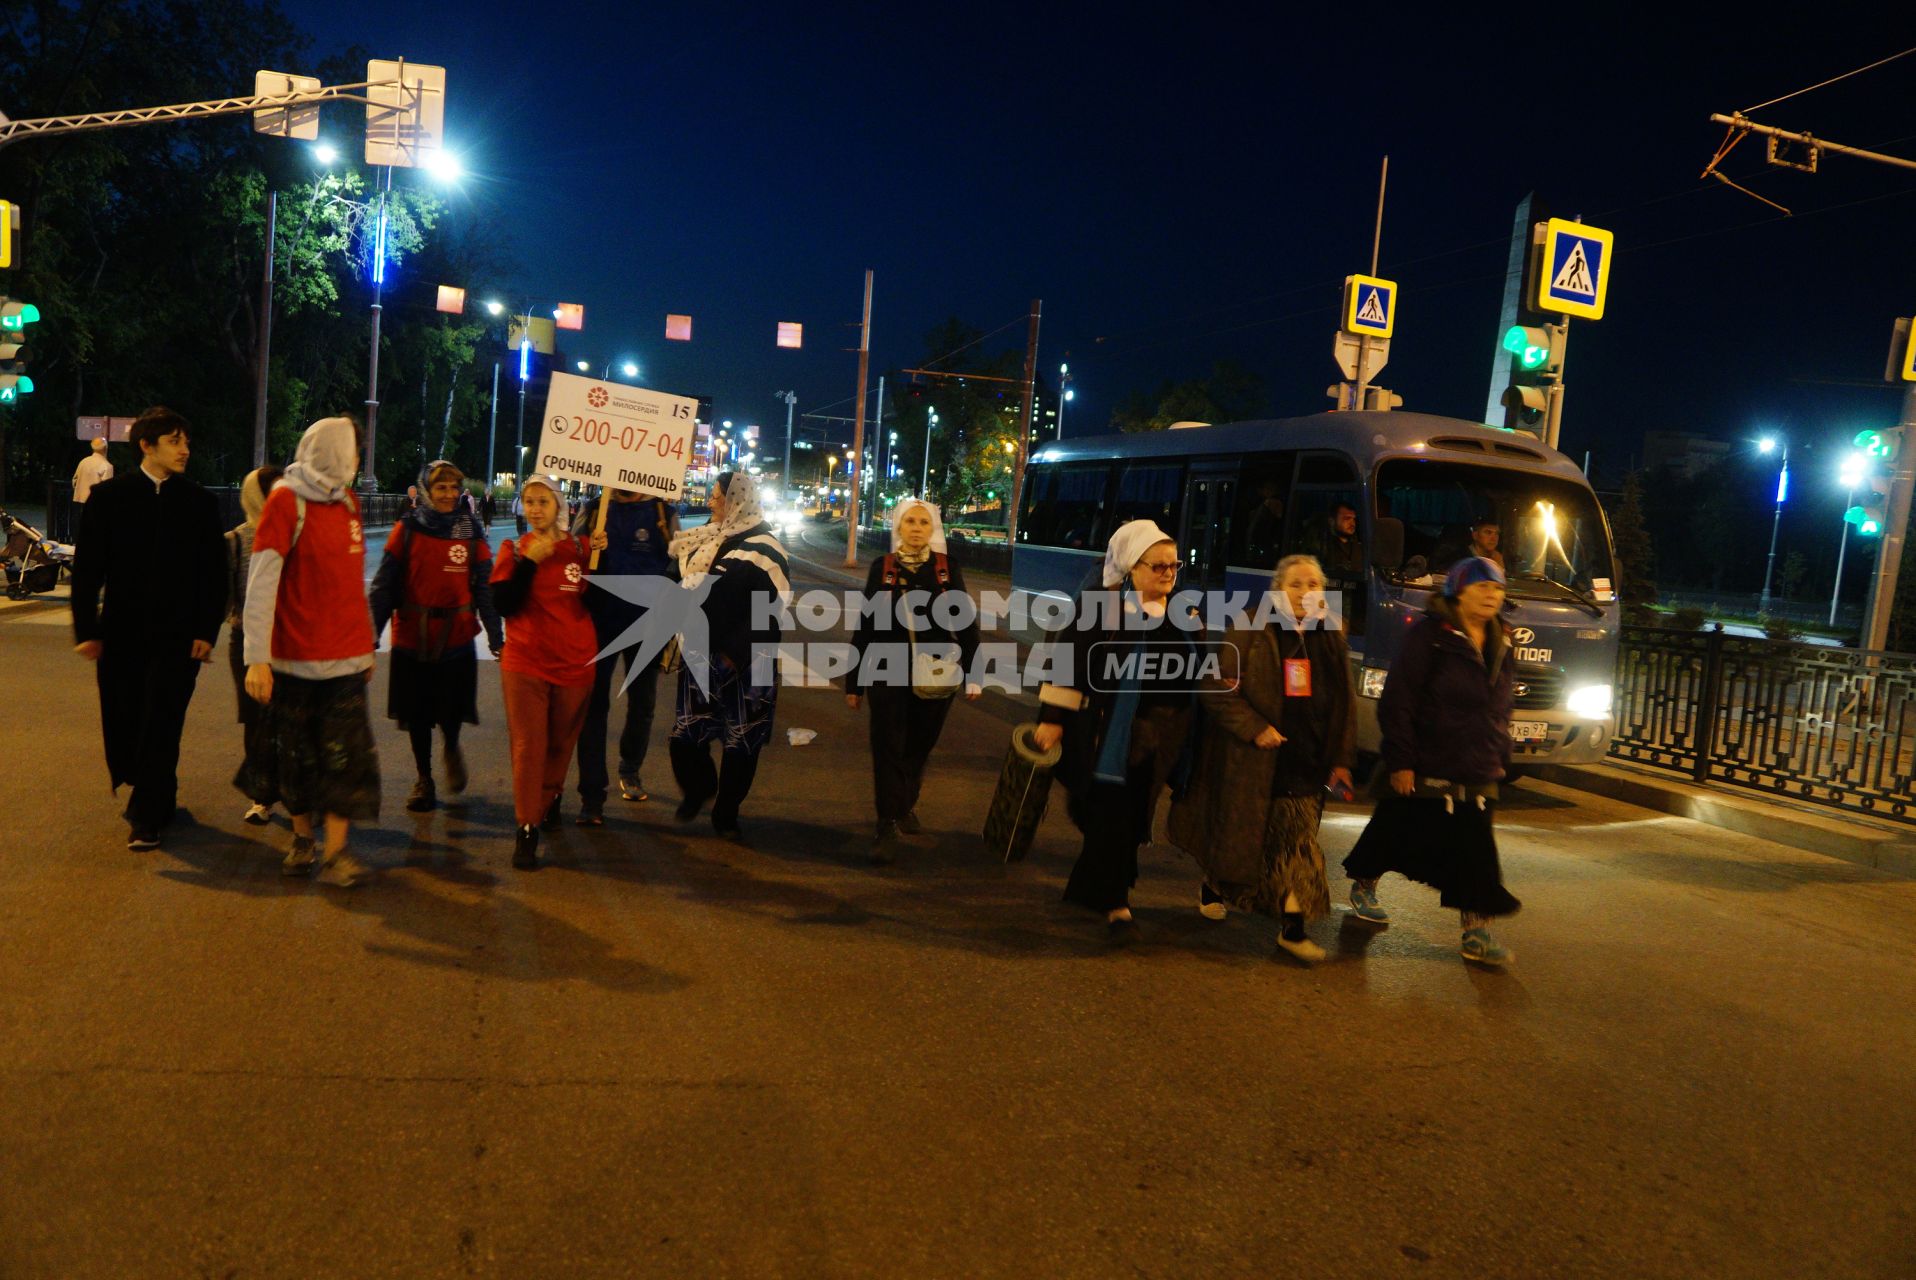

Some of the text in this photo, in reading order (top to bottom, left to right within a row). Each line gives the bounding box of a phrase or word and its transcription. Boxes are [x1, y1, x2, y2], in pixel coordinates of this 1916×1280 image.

[612, 401, 659, 416] МИЛОСЕРДИЯ
[672, 403, 690, 420] 15
[569, 416, 684, 461] 200-07-04
[542, 454, 677, 493] СРОЧНАЯ ПОМОЩЬ
